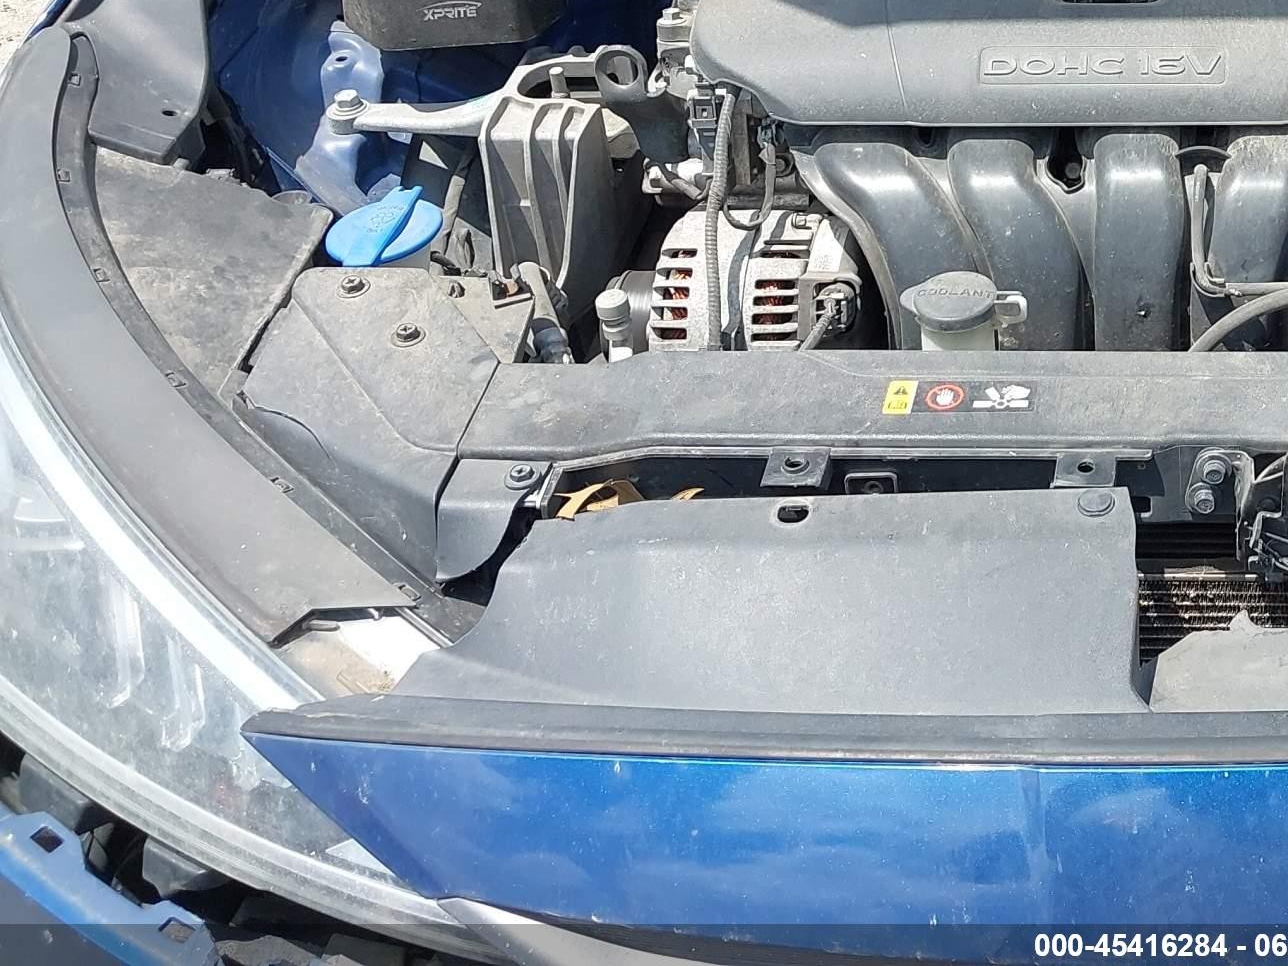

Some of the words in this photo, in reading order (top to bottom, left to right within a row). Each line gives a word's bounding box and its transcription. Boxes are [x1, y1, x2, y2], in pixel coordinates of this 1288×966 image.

[424, 6, 477, 21] XPRITE
[983, 54, 1125, 76] DOHC
[1139, 54, 1222, 76] 16V
[917, 288, 994, 299] COOLANT
